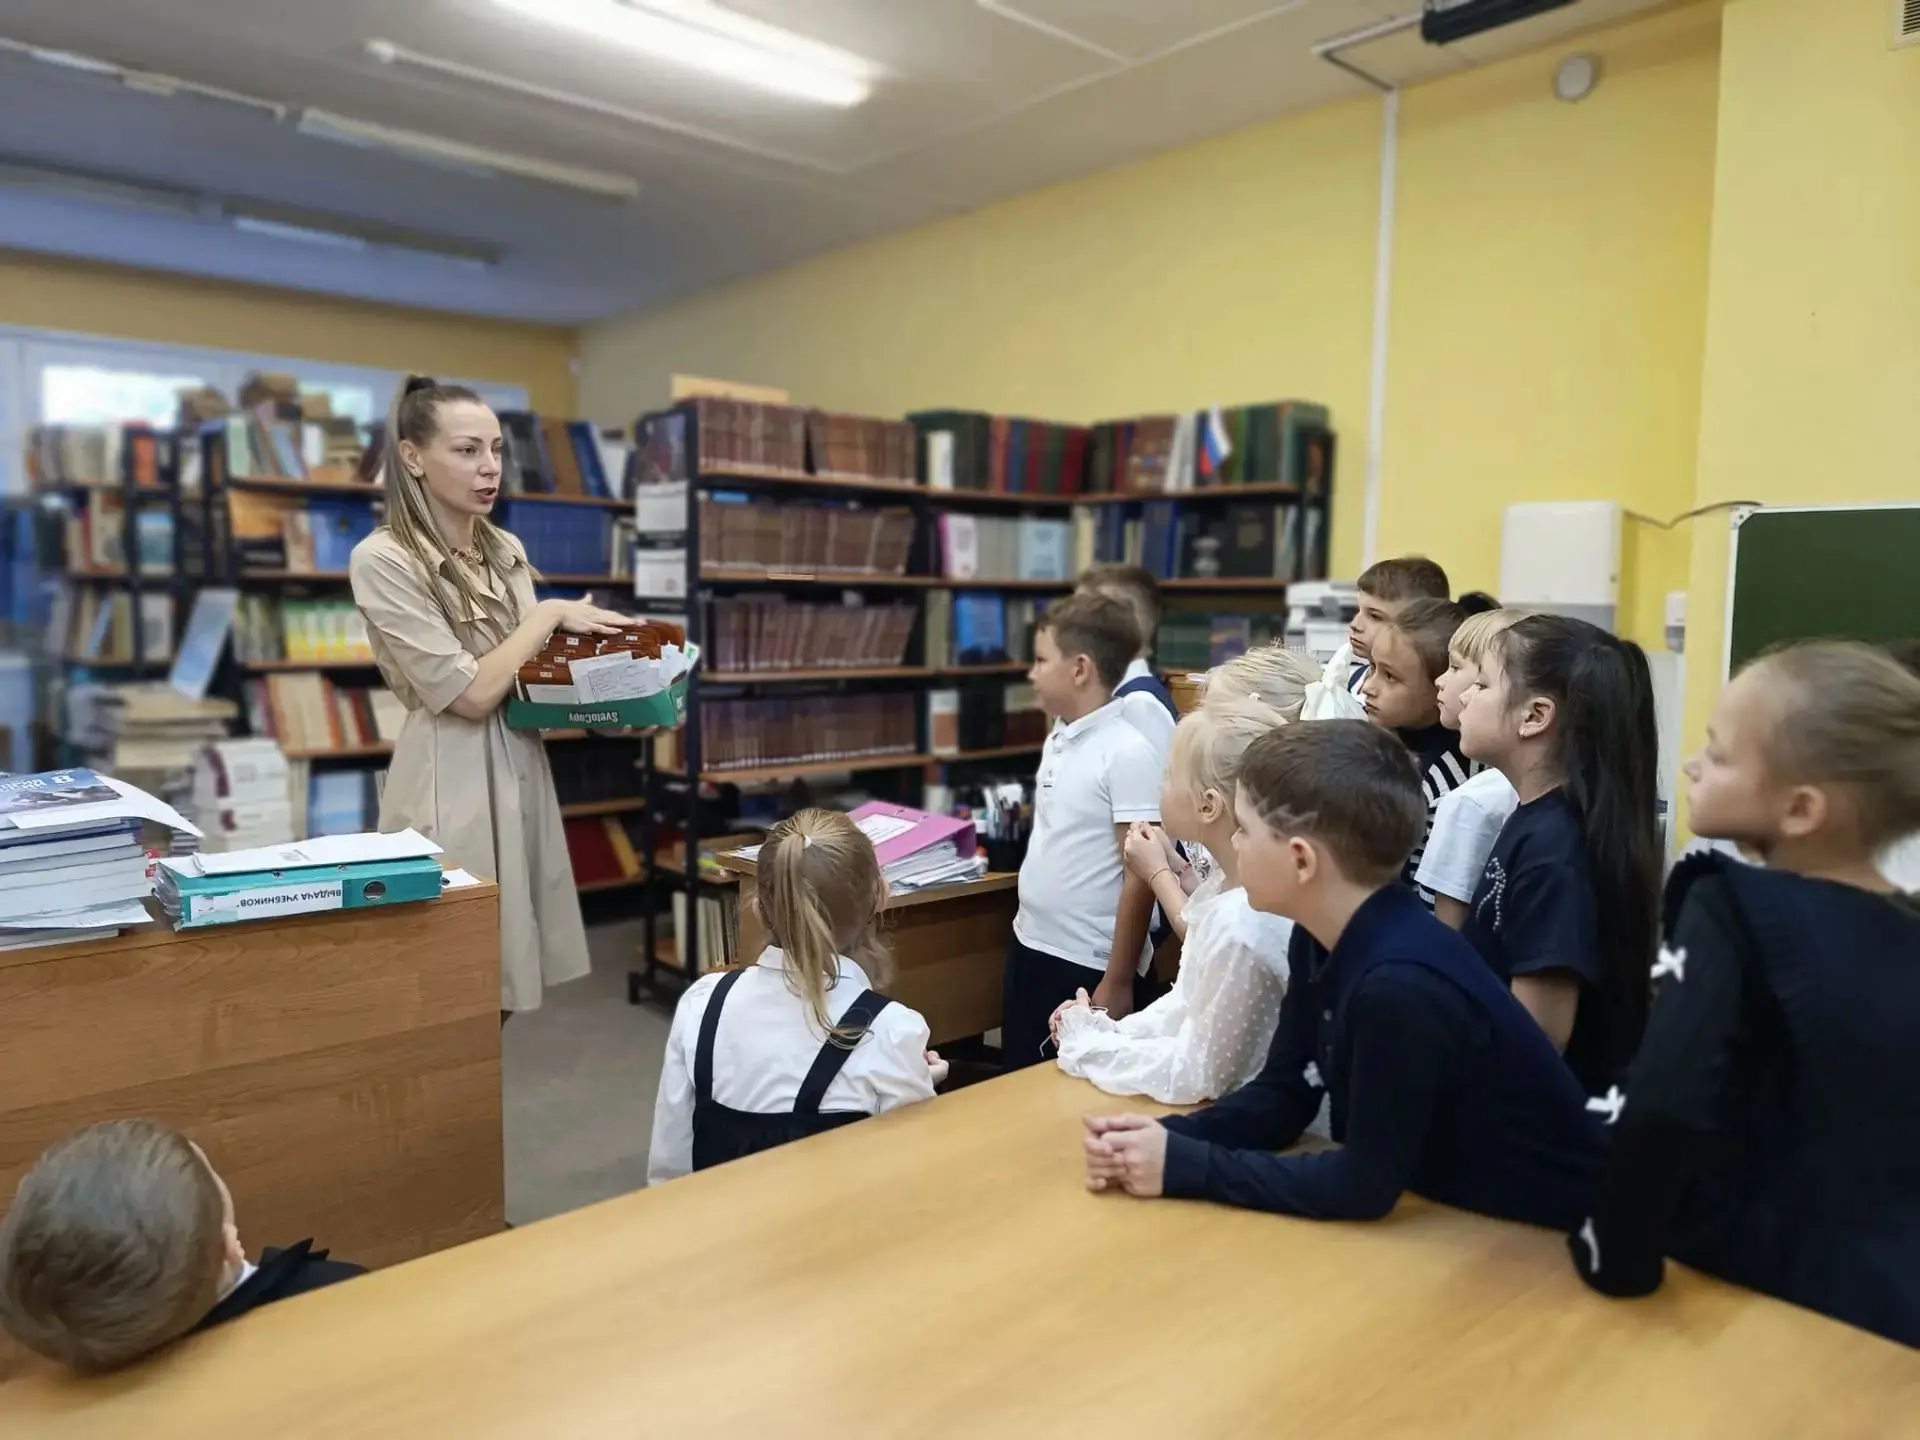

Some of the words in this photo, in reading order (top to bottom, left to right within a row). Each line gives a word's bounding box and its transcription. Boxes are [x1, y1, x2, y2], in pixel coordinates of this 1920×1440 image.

[568, 712, 618, 724] SvetoCopy
[240, 893, 299, 907] УЧЕБНИКОВ
[301, 889, 341, 900] ВЫДАЧА
